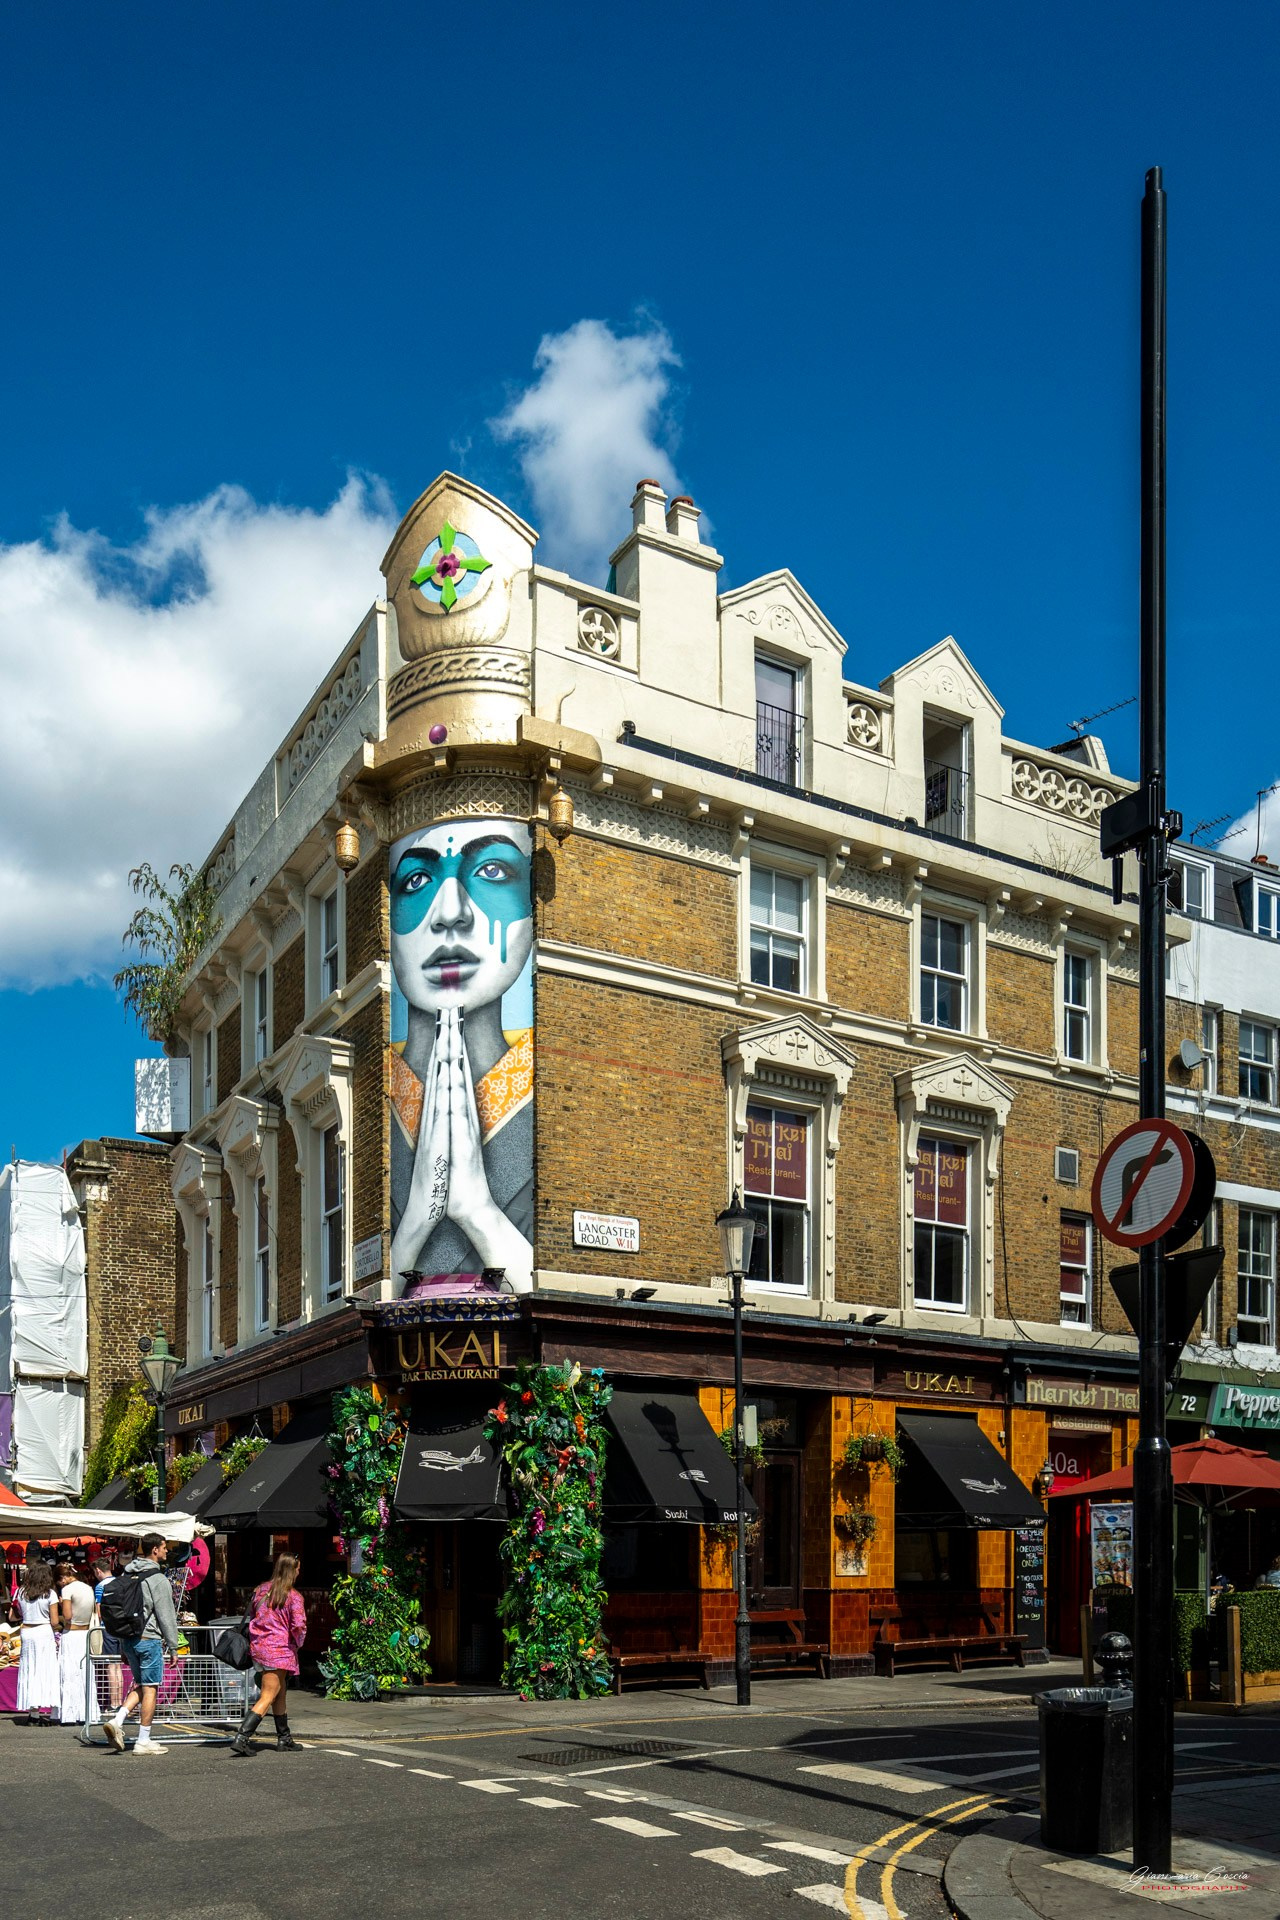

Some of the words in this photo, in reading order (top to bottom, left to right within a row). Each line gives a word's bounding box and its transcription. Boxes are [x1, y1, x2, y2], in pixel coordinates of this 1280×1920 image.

[751, 1139, 792, 1161] Thai
[919, 1168, 954, 1188] Thai
[578, 1222, 636, 1239] LANCASTER
[398, 1330, 500, 1369] UKAI
[402, 1371, 420, 1383] BAR
[424, 1368, 499, 1381] RESTAURANT
[902, 1370, 975, 1394] UKAI
[1026, 1379, 1097, 1408] Market
[1180, 1395, 1197, 1412] 72
[178, 1404, 204, 1426] UKAI
[1053, 1414, 1111, 1431] Restaurant
[665, 1510, 688, 1520] Sushi
